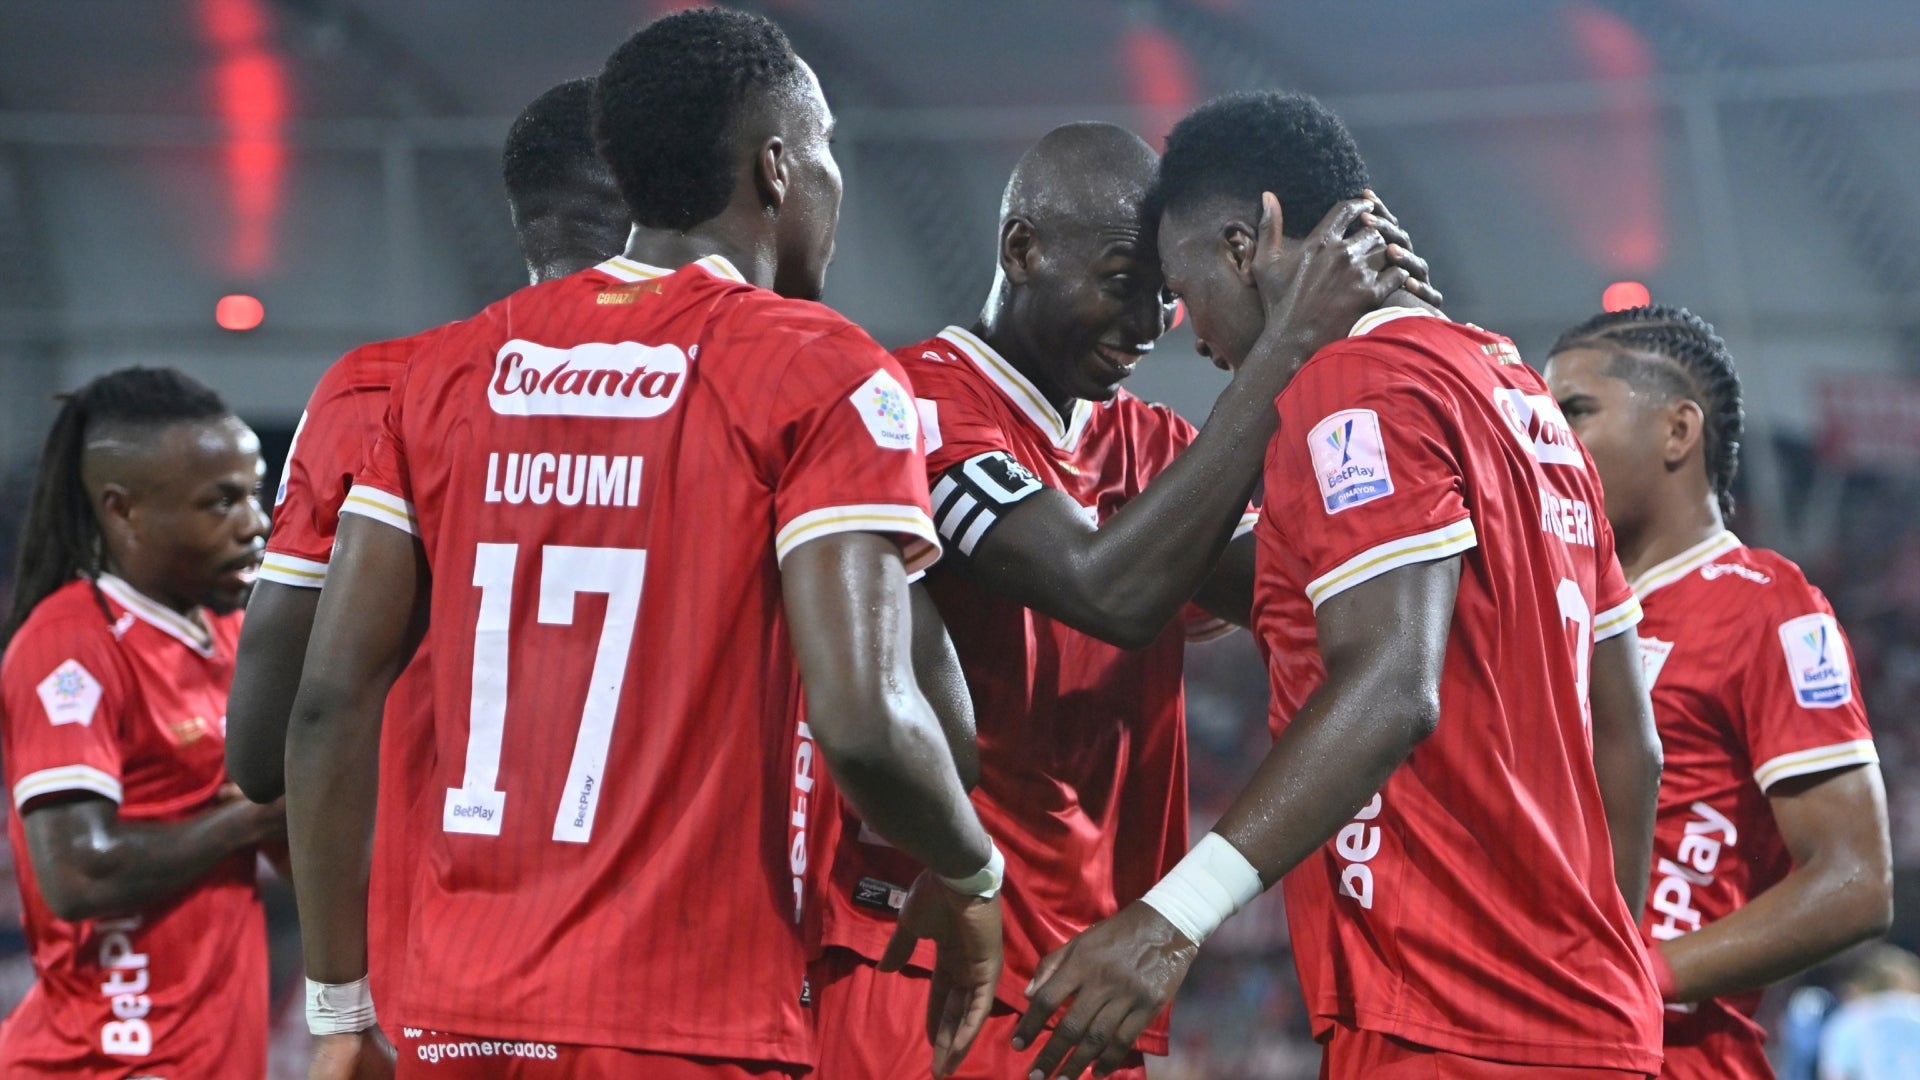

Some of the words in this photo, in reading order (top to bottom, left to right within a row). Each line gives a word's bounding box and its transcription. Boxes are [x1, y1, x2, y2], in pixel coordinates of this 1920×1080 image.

[494, 352, 681, 399] Colanta
[484, 452, 643, 507] LUCUMI
[1328, 465, 1375, 489] BetPlay
[1338, 485, 1376, 502] DIMAYOR
[442, 542, 647, 844] 17
[453, 804, 495, 821] BetPlay
[574, 775, 594, 828] BetPlay
[417, 1041, 558, 1064] agromercados
